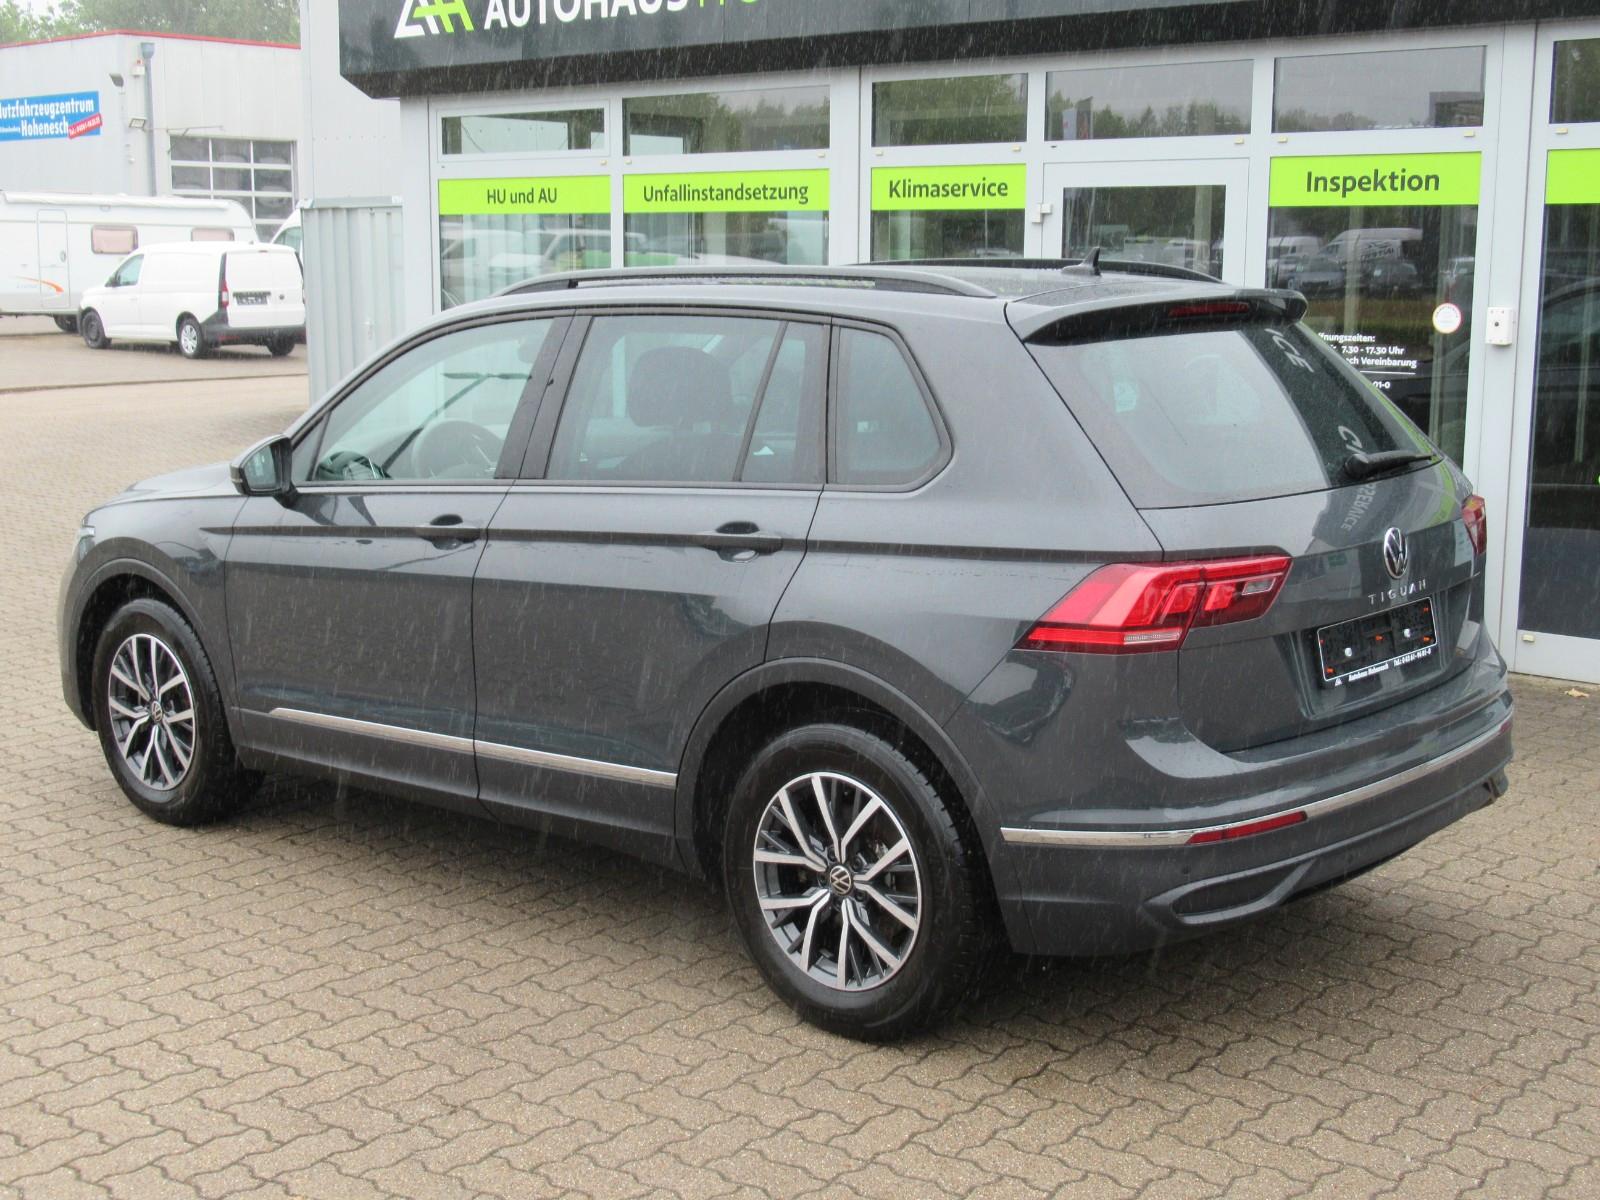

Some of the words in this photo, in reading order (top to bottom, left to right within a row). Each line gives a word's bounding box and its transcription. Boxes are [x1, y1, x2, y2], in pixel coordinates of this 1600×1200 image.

[0, 98, 94, 119] utzfahrzeugzentrum
[21, 116, 69, 136] Hohenesch
[888, 177, 1008, 198] Klimaservice
[1306, 168, 1440, 198] Inspektion
[487, 188, 506, 204] HU
[510, 187, 534, 204] und
[538, 187, 557, 204] AU
[643, 183, 809, 205] Unfallinstandsetzung
[1342, 345, 1359, 355] 7.30
[1365, 346, 1387, 355] 17.30
[1388, 346, 1405, 355] Uhr
[1361, 357, 1417, 368] Vereinbarung
[1367, 579, 1426, 605] TIGUAN
